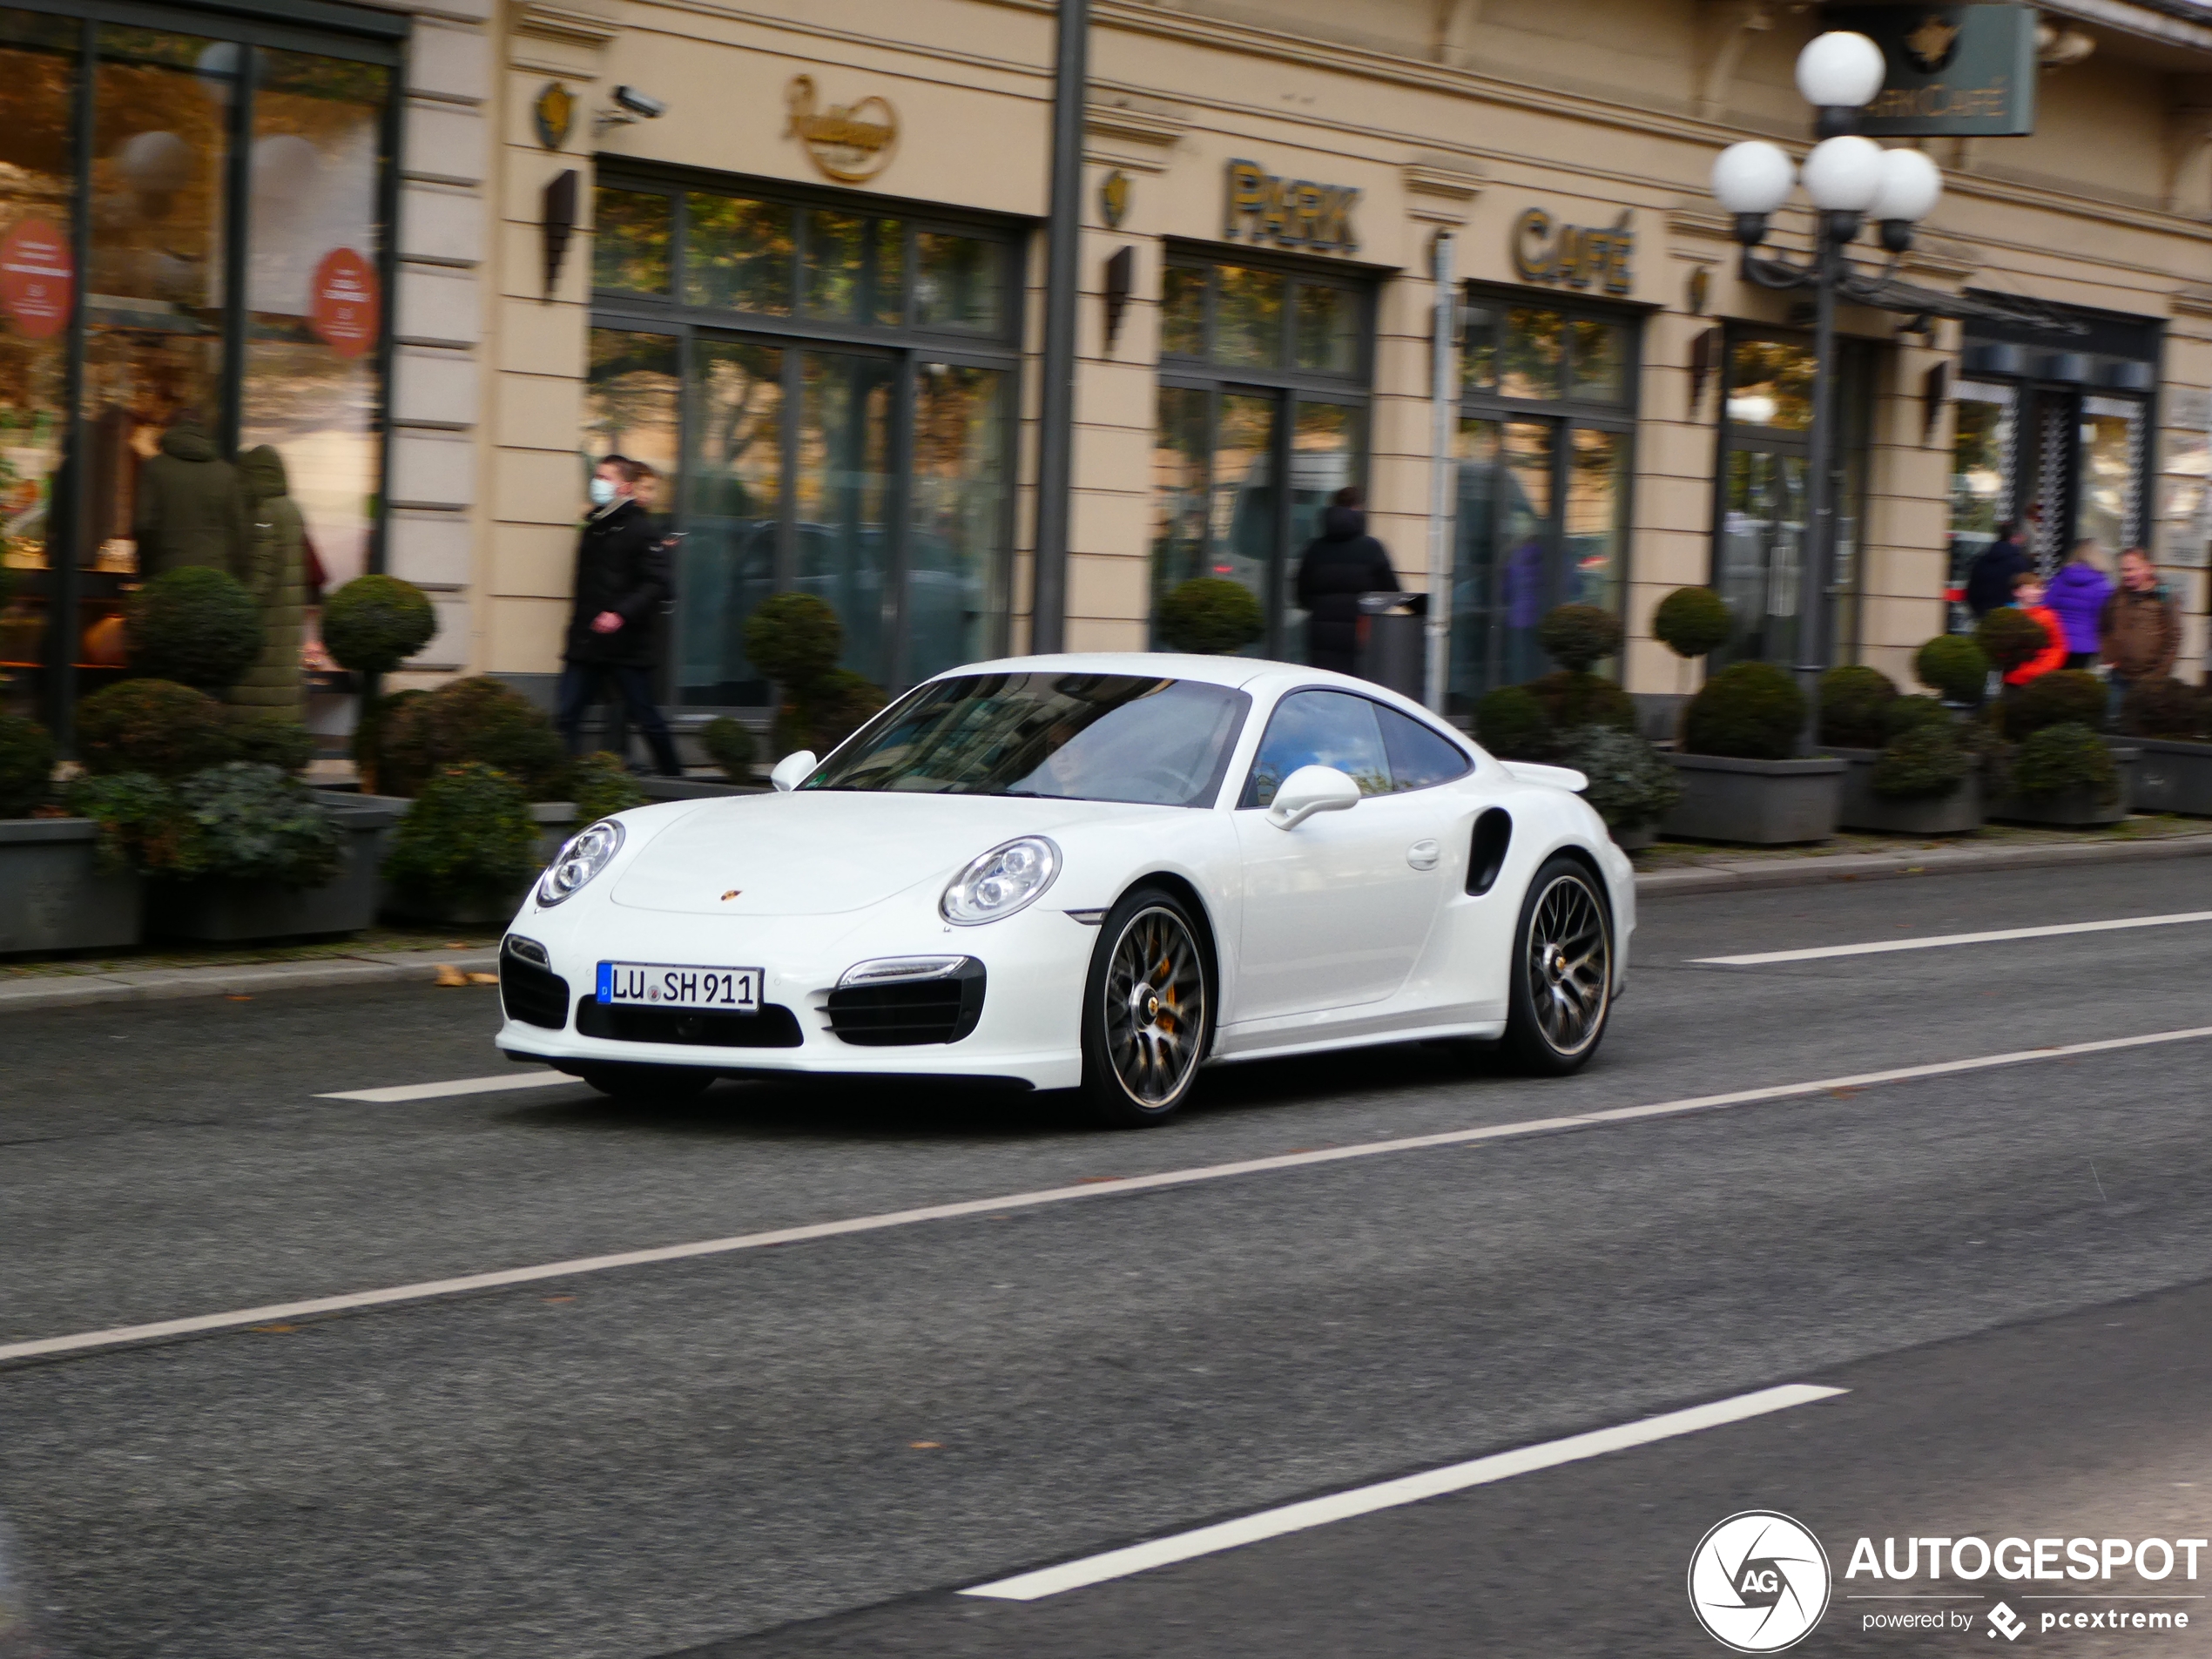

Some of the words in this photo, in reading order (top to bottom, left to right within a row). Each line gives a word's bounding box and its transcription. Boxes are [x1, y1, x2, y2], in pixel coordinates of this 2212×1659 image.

[1223, 158, 1363, 253] PARK
[1509, 207, 1636, 294] CAFÉ
[613, 969, 644, 999] LU
[663, 973, 697, 1002] SH
[704, 974, 753, 1004] 911
